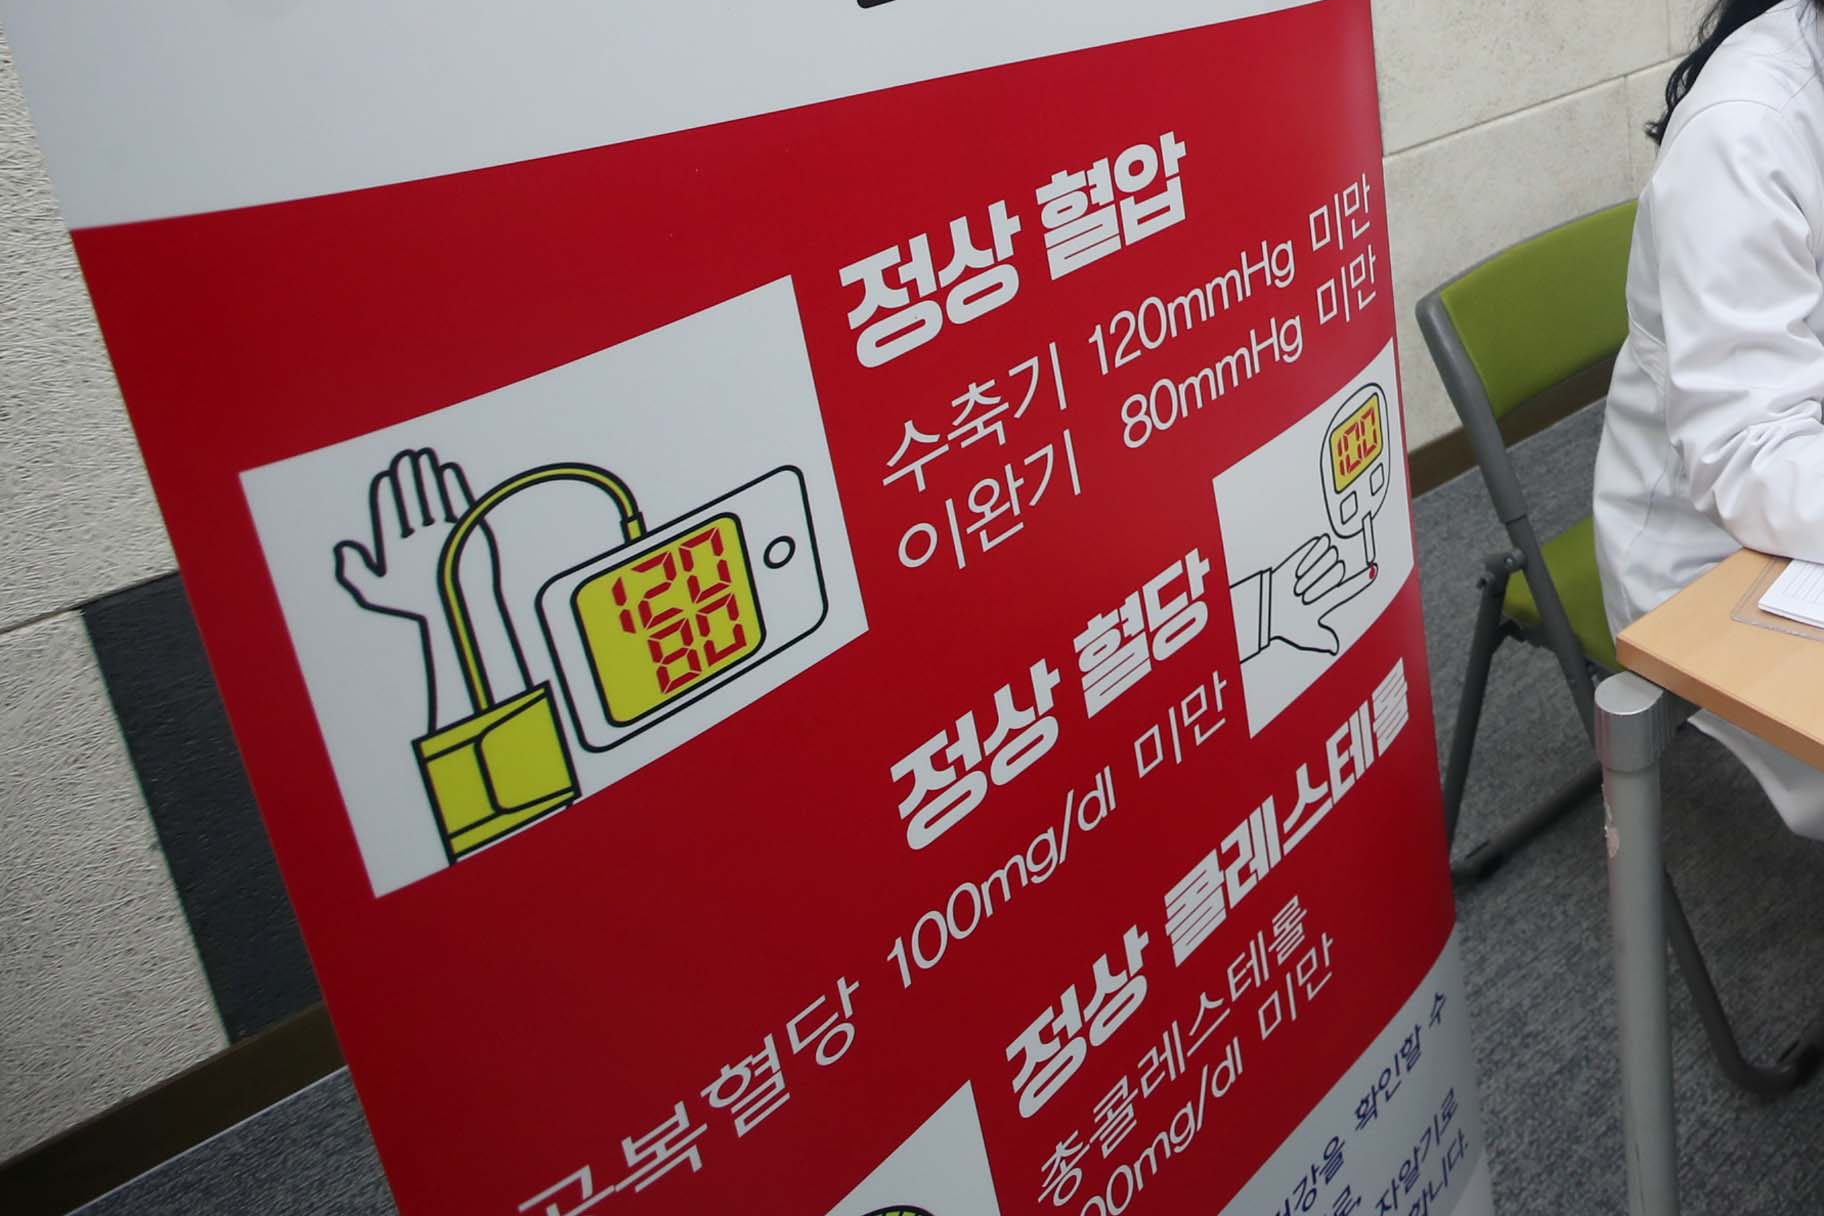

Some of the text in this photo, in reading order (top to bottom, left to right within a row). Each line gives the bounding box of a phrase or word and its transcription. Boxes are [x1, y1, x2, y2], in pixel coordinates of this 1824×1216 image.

[838, 130, 1188, 369] 정상 혈압
[881, 173, 1370, 493] 수축기 120mmHg 미만
[897, 245, 1377, 570] 이완기 80mmHg 미만
[1337, 406, 1379, 478] 100
[612, 526, 732, 635] 120
[646, 591, 747, 695] 80
[889, 547, 1212, 851] 정상 혈당
[886, 765, 1118, 990] 100mg/dl
[1133, 670, 1228, 779] 미만
[1004, 656, 1410, 1119] 정상 콜레스테롤
[1037, 894, 1308, 1207] 총콜레스테롤
[1257, 932, 1334, 1041] 미만
[1354, 1023, 1423, 1132] 확인할
[1428, 991, 1447, 1030] 수
